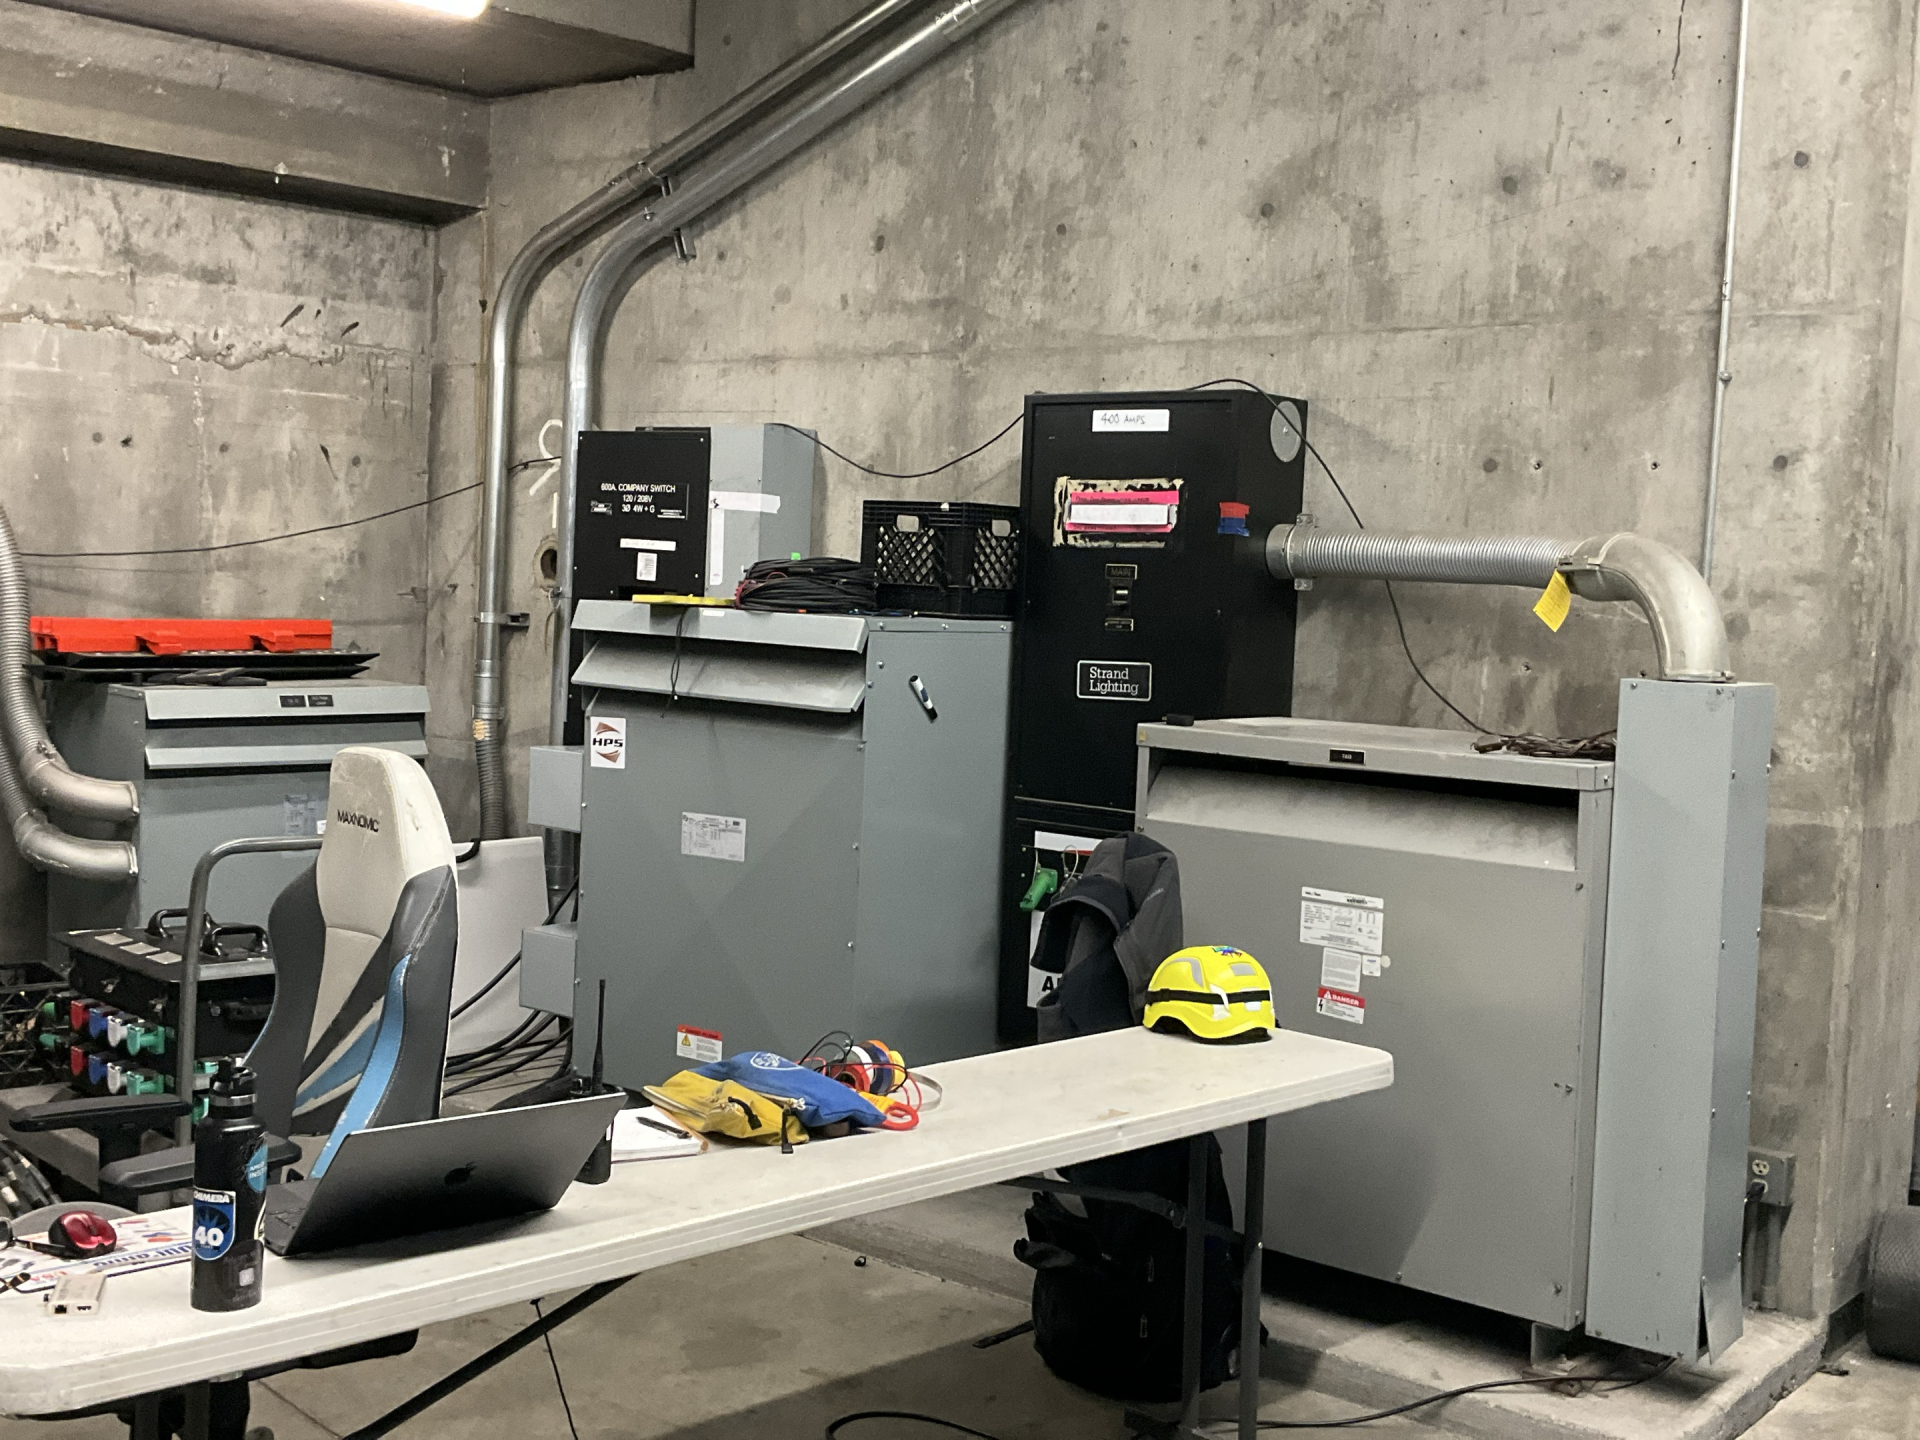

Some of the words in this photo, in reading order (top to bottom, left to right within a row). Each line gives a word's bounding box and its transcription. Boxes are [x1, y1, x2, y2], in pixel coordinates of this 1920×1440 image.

[1101, 412, 1120, 425] 400
[1123, 414, 1146, 425] AMPS
[618, 483, 650, 492] COMPANY
[650, 484, 676, 493] SWITCH
[623, 494, 633, 502] 120
[637, 494, 653, 503] 208V
[633, 504, 644, 513] 4W
[649, 504, 655, 513] G
[1089, 666, 1129, 680] Strand
[1089, 679, 1139, 696] Lighting
[592, 737, 624, 748] HPS
[337, 809, 380, 833] MAXNOMIC
[1332, 993, 1360, 1007] DANGER
[195, 1225, 224, 1247] 40
